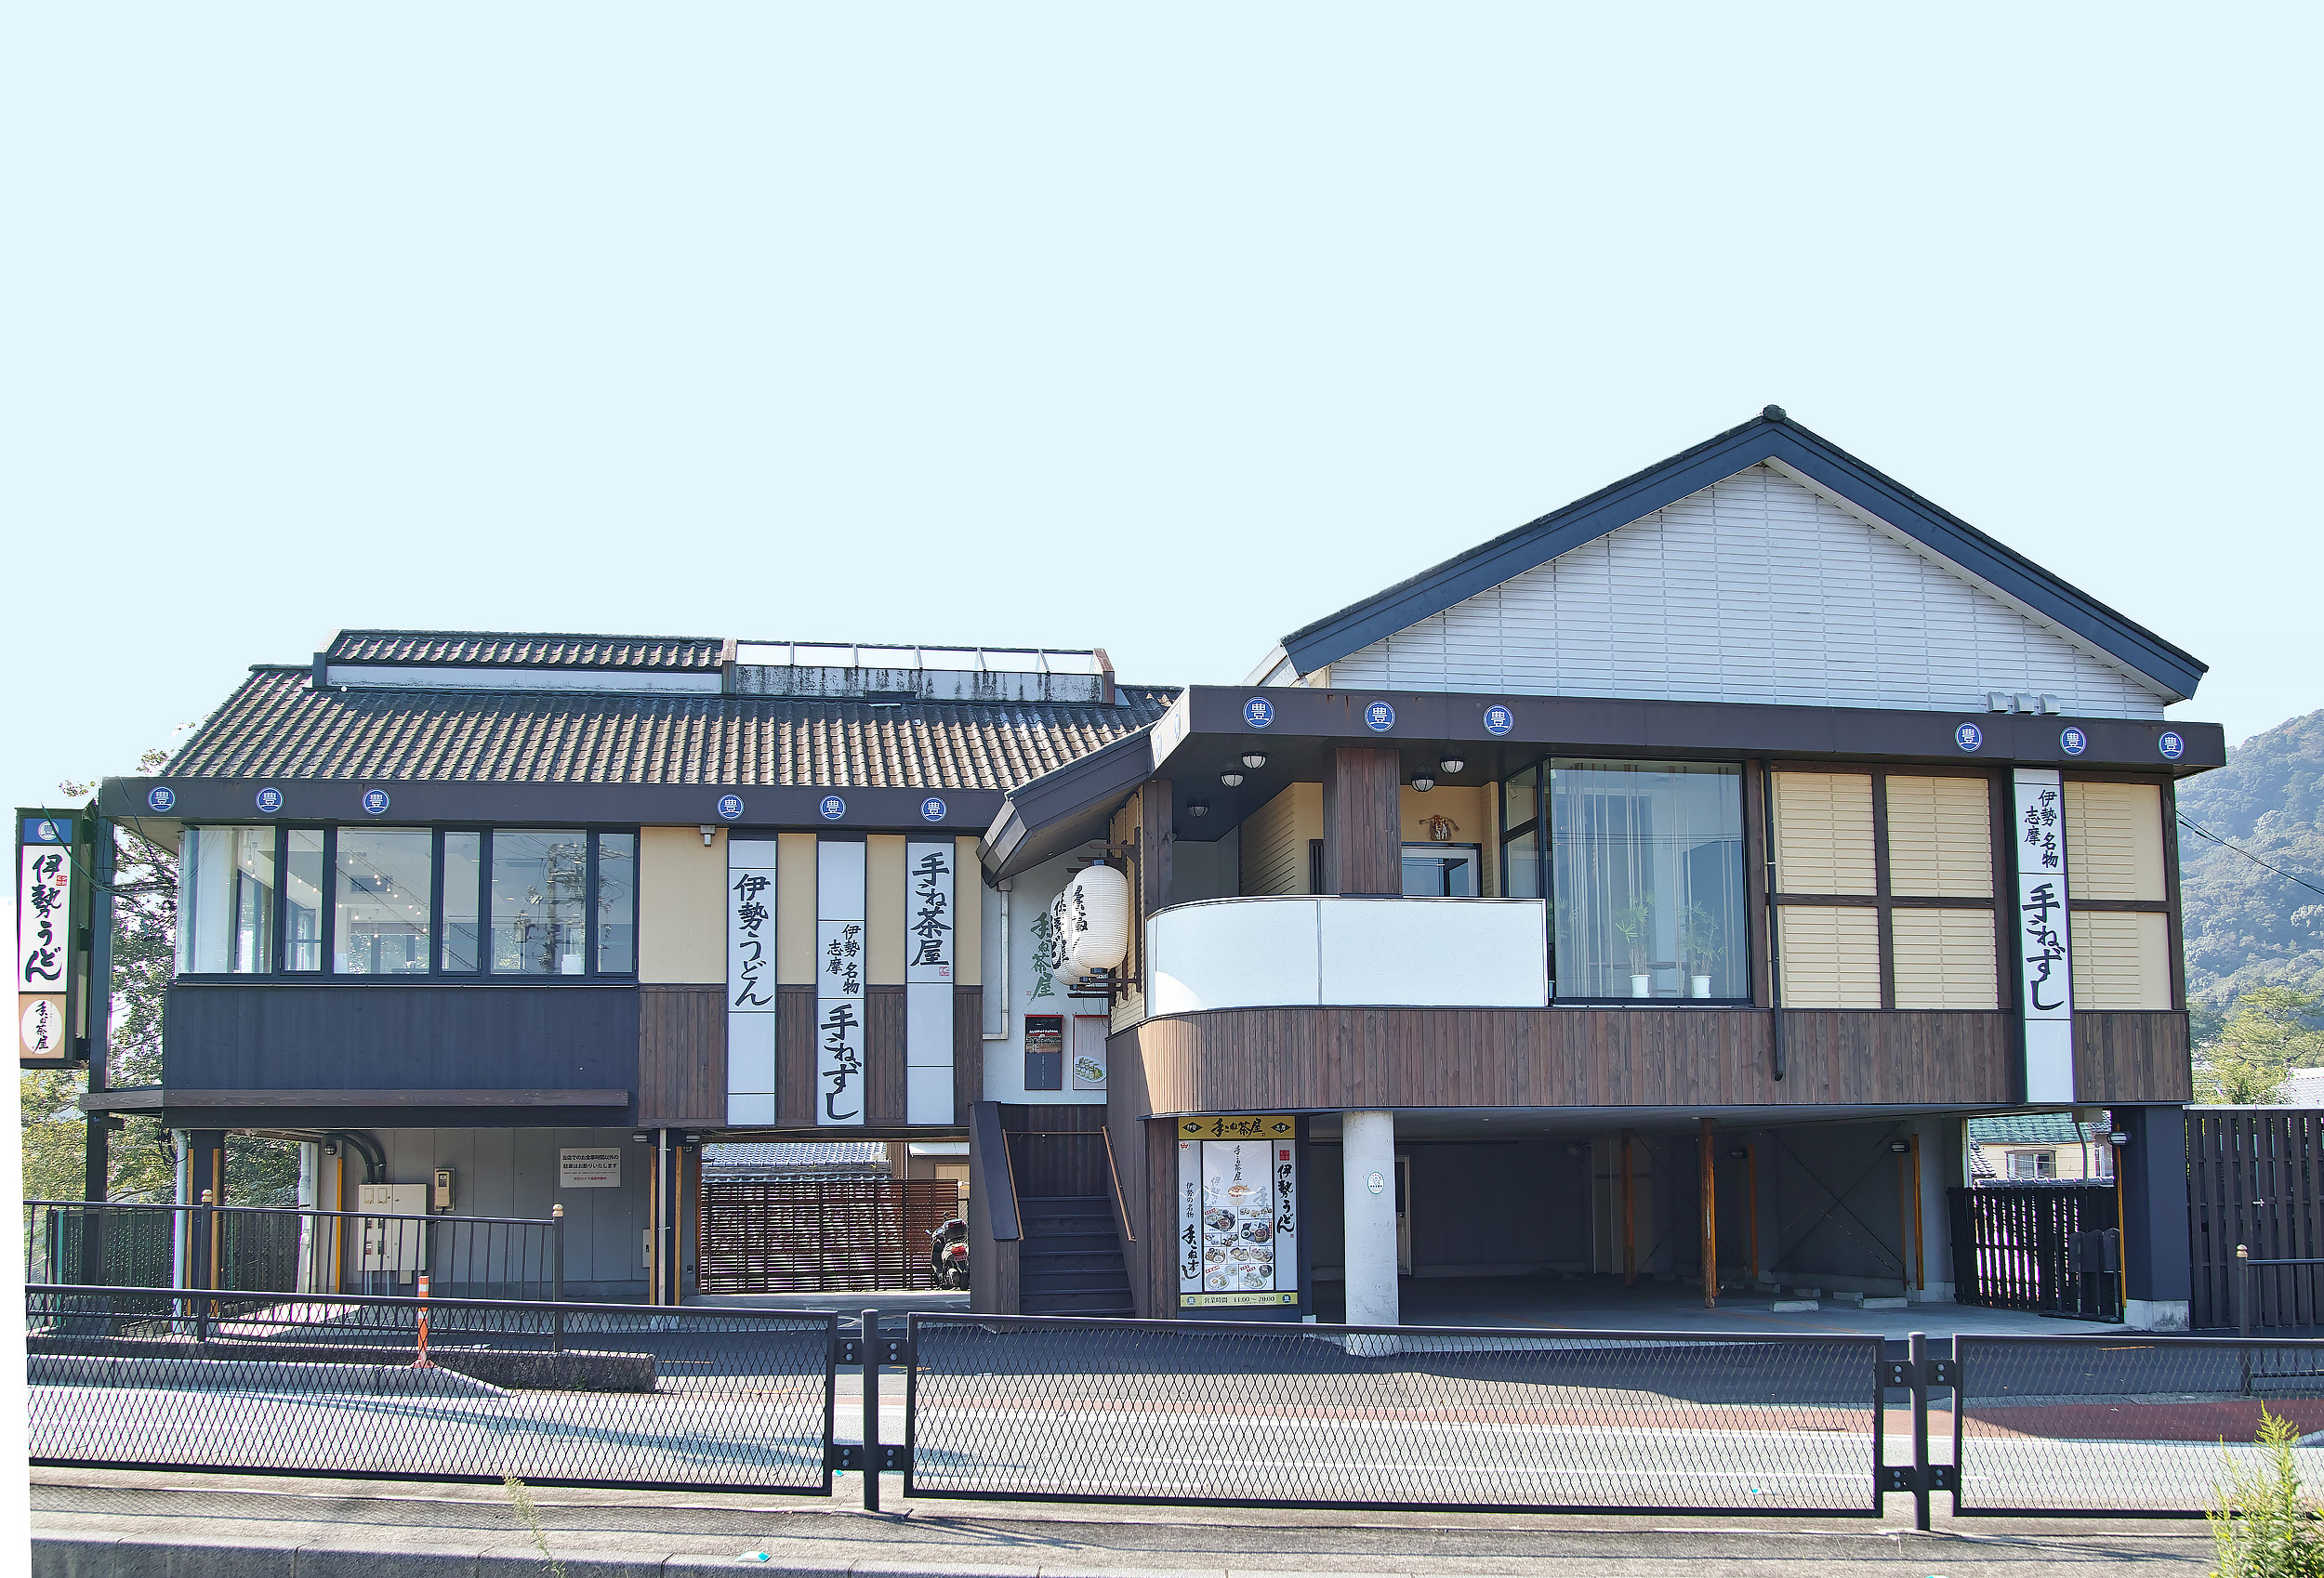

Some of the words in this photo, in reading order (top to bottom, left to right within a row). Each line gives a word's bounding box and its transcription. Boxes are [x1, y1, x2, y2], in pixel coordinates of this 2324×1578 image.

[2024, 806, 2041, 846] 志摩
[25, 854, 62, 982] 伊勢うどん
[733, 873, 773, 1006] 伊勢うどん
[825, 939, 843, 975] 志摩
[909, 851, 952, 967] 手こね茶屋
[2022, 883, 2066, 1010] 手こねずし
[820, 1003, 863, 1120] 手こねずし
[1181, 1224, 1200, 1280] 手こねずし
[1276, 1164, 1295, 1234] 伊勢うどん
